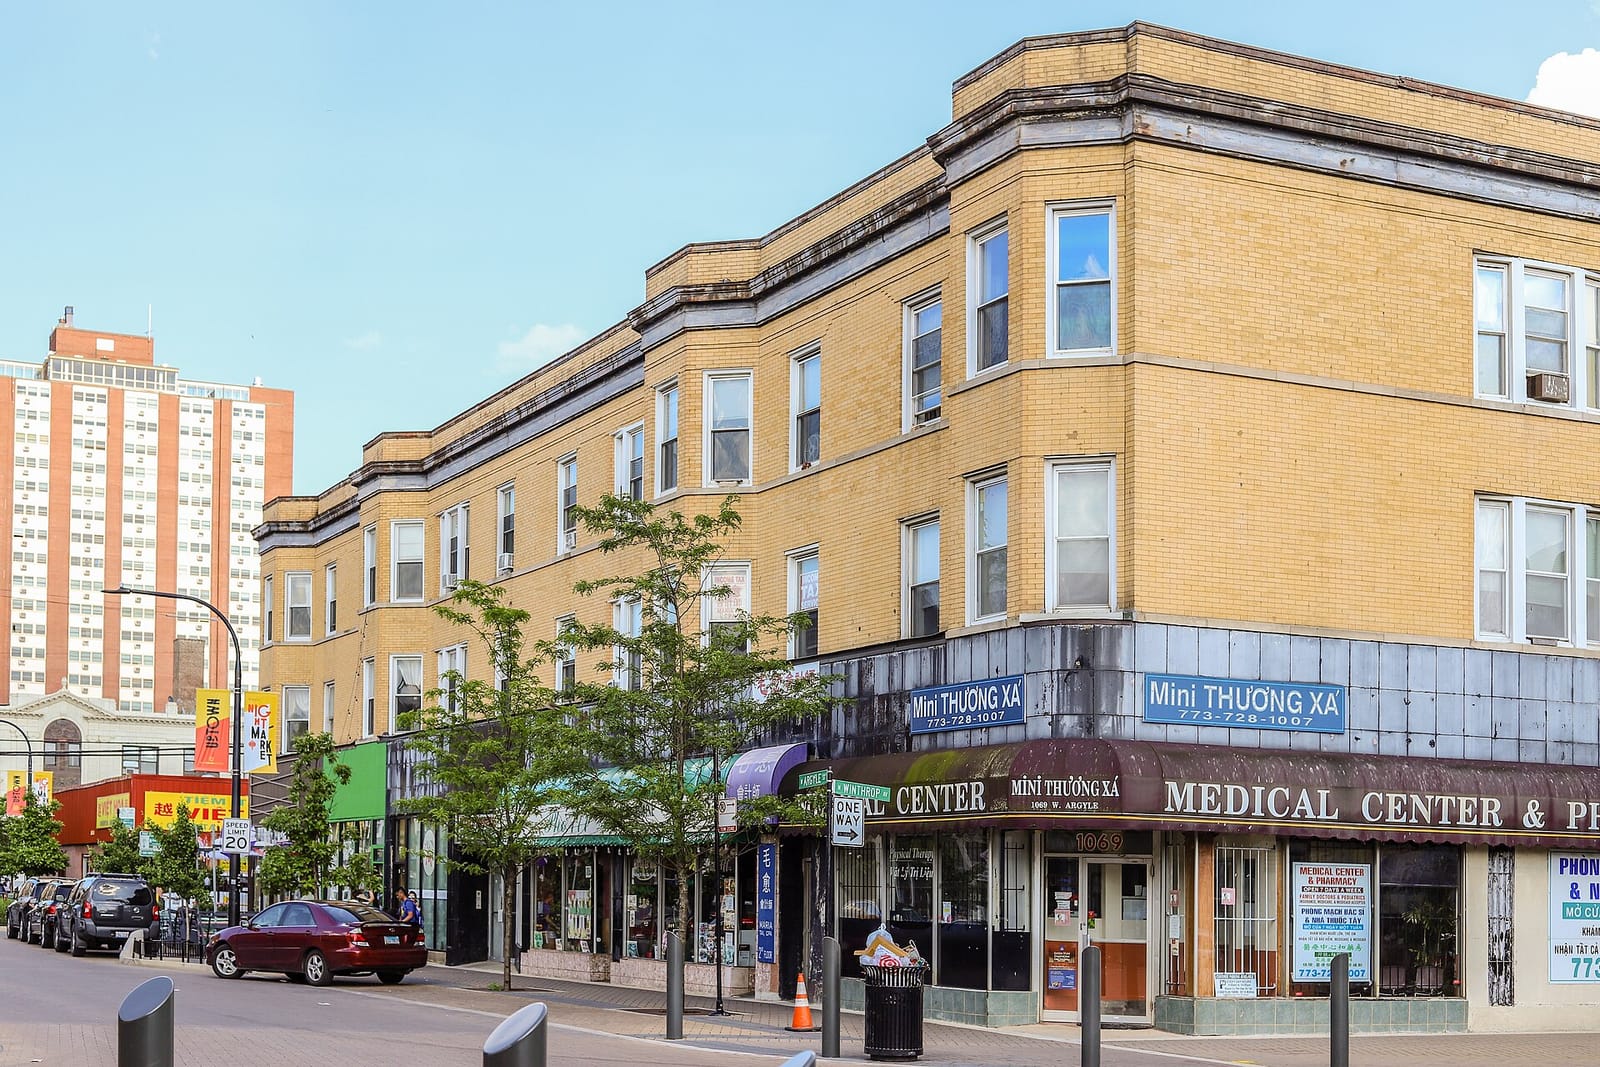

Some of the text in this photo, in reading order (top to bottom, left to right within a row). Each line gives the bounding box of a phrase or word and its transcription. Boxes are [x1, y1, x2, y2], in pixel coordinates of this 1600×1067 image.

[913, 679, 1022, 718] Mini THƯƠNG XÁ
[1150, 680, 1341, 716] Mini THƯƠNG XÁ
[206, 698, 220, 748] UPTOWN
[927, 711, 1005, 728] 773-728-1007
[1178, 709, 1313, 727] 773-728-1007
[803, 773, 822, 786] ARGYLE
[1101, 775, 1120, 797] XÁ
[843, 783, 880, 798] WINTHROP
[896, 781, 986, 815] CENTER
[154, 802, 173, 817] 越
[836, 801, 860, 813] ONE
[1031, 801, 1099, 810] 1069 W. ARGYLE
[1164, 781, 1339, 820] MEDICAL
[1361, 791, 1503, 828] CENTER
[1522, 799, 1546, 829] &
[836, 815, 860, 827] WAY
[226, 837, 247, 849] 20
[1076, 832, 1124, 852] 1069
[1300, 867, 1364, 876] MEDICAL CENTER
[1308, 876, 1358, 885] & PHARMACY
[1570, 882, 1600, 900] & N
[1566, 904, 1581, 917] MỞ
